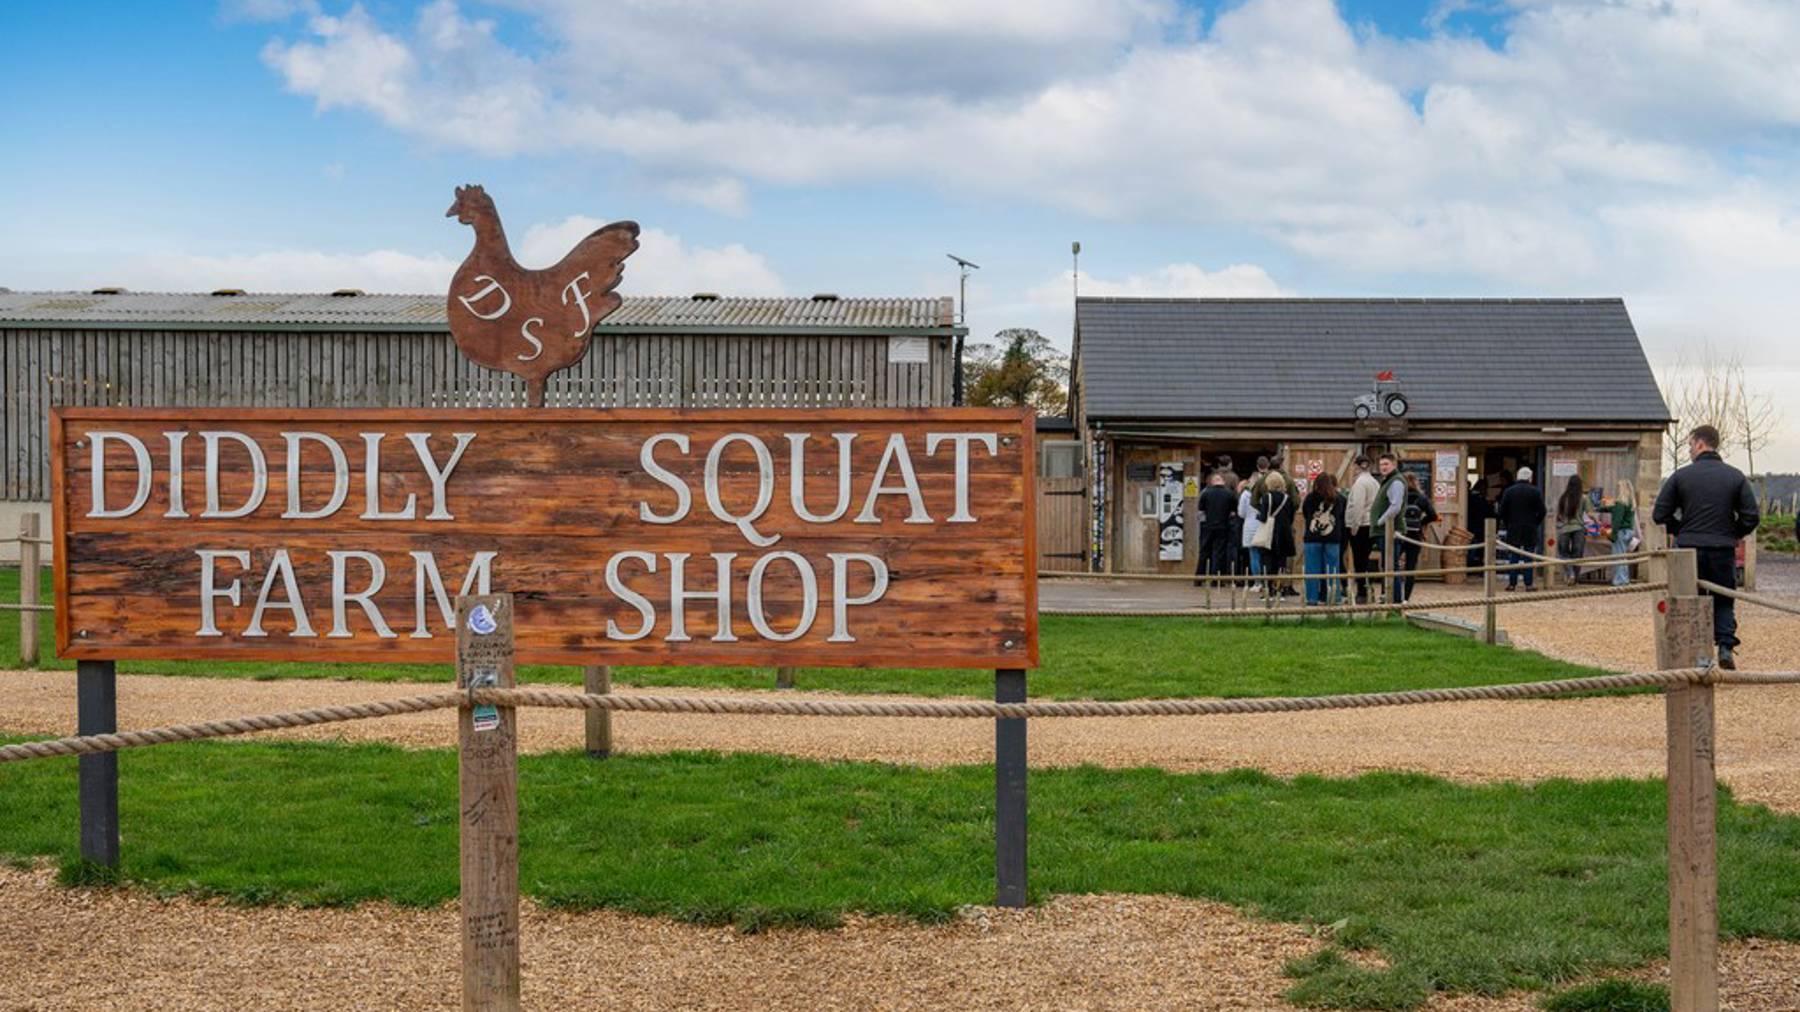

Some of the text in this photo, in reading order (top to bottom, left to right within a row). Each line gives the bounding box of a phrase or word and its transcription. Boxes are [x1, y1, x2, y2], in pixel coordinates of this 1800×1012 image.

[458, 271, 592, 361] D S F
[85, 431, 477, 521] DIDDLY
[639, 432, 998, 547] SQUAT
[195, 549, 889, 642] FARM SHOP
